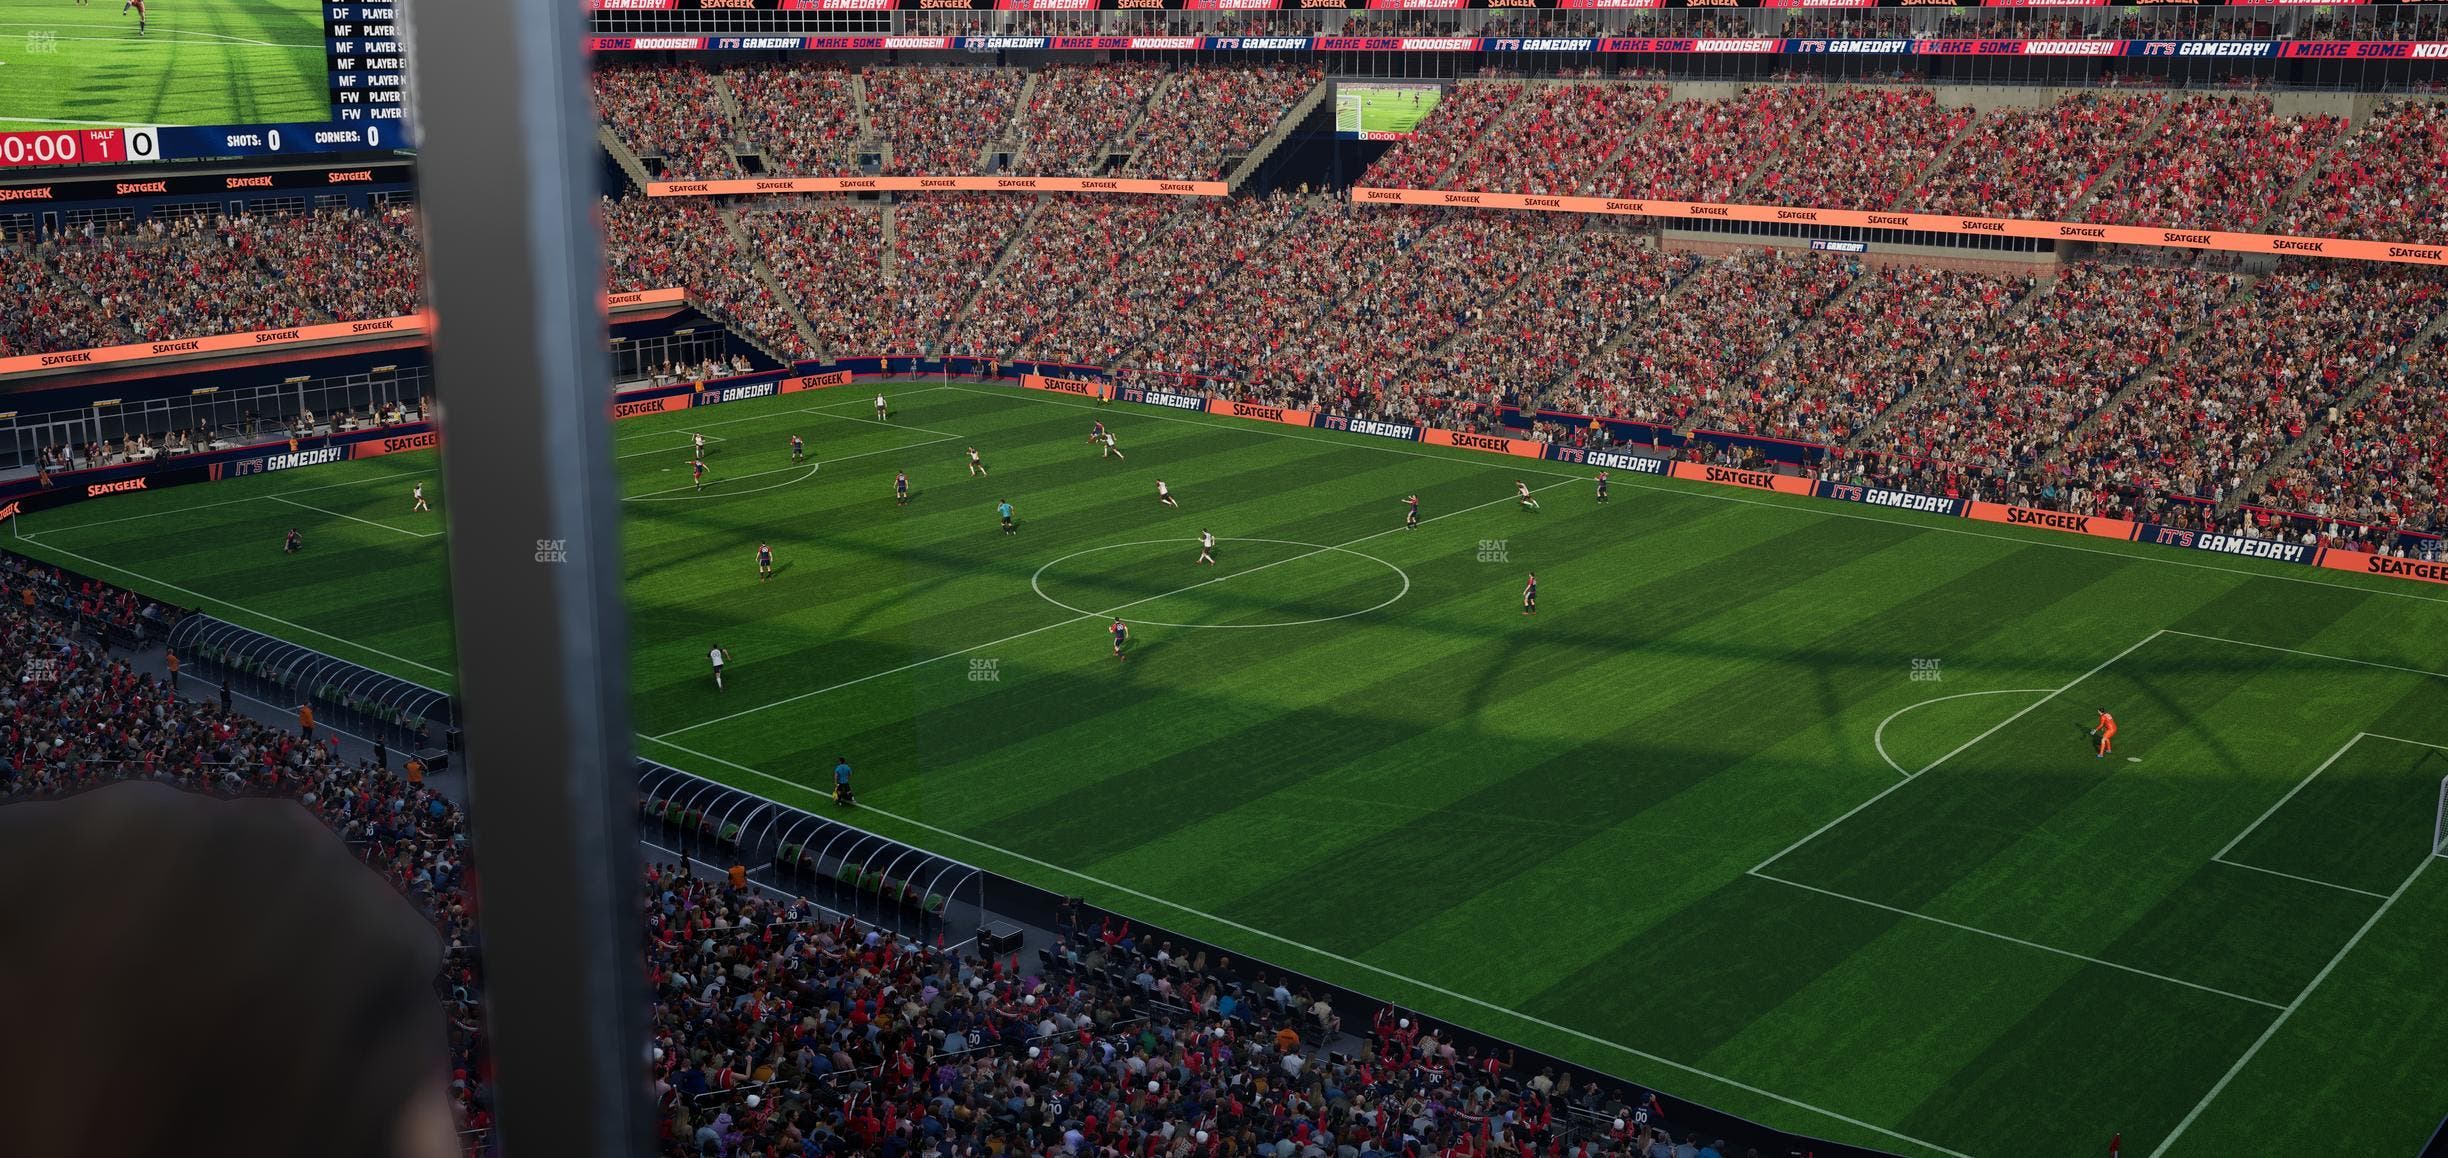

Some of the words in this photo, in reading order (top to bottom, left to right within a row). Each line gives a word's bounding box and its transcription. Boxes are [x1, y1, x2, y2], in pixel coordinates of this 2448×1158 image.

[920, 0, 971, 8] SEATGEEK
[1118, 0, 1163, 8] SEATGEEK
[333, 8, 349, 19] DF
[362, 9, 393, 19] PLAYER
[335, 25, 352, 36] MF
[364, 25, 395, 36] PLAYER
[336, 42, 353, 53] MF
[365, 42, 396, 53] PLAYER
[600, 39, 632, 48] SOME
[743, 39, 800, 48] GAMEDAY!
[816, 39, 848, 48] MAKE
[853, 39, 882, 48] SOME
[988, 39, 1045, 48] GAMEDAY!
[1061, 39, 1093, 48] MAKE
[1098, 39, 1128, 48] SOME
[1216, 39, 1240, 48] IT'S
[1242, 39, 1306, 48] GAMEDAY!
[1324, 39, 1360, 49] MAKE
[1365, 39, 1399, 49] SOME
[1494, 40, 1520, 50] IT'S
[1522, 40, 1592, 50] GAMEDAY!
[1610, 40, 1650, 50] MAKE
[1655, 40, 1693, 51] SOME
[1798, 41, 1826, 52] IT'S
[1829, 41, 1907, 52] GAMEDAY!
[1978, 42, 2022, 53] SOME
[2144, 43, 2176, 55] IT'S
[2179, 43, 2270, 56] GAMEDAY!
[2296, 44, 2350, 56] MAKE
[2356, 44, 2410, 56] SOME
[337, 59, 355, 70] MF
[366, 59, 397, 69] PLAYER
[339, 75, 356, 87] MF
[368, 75, 399, 86] PLAYER
[341, 92, 360, 103] FW
[369, 92, 400, 102] PLAYER
[342, 109, 361, 120] FW
[371, 108, 401, 119] PLAYER
[90, 131, 114, 140] HALF
[227, 135, 262, 147] SHOTS:
[268, 129, 281, 151] 0
[315, 130, 361, 144] CORNERS:
[367, 126, 379, 147] 0
[0, 134, 76, 163] 0:00
[100, 141, 108, 159] 1
[132, 132, 152, 156] 0
[226, 176, 273, 189] SEATGEEK
[328, 170, 373, 183] SEATGEEK
[116, 181, 167, 195] SEATGEEK
[669, 184, 708, 192] SEATGEEK
[757, 182, 793, 190] SEATGEEK
[840, 180, 875, 188] SEATGEEK
[1160, 183, 1194, 191] SEATGEEK
[0, 187, 53, 201] SEATGEEK
[1368, 191, 1401, 199] SEATGEEK
[1445, 194, 1480, 203] SEATGEEK
[1525, 198, 1560, 207] SEATGEEK
[1606, 202, 1643, 211] SEATGEEK
[1691, 206, 1728, 215] SEATGEEK
[1778, 210, 1816, 220] SEATGEEK
[1868, 216, 1908, 225] SEATGEEK
[1962, 221, 2005, 231] SEATGEEK
[2060, 227, 2106, 237] SEATGEEK
[2164, 233, 2211, 245] SEATGEEK
[2273, 240, 2323, 252] SEATGEEK
[2389, 247, 2442, 260] SEATGEEK
[608, 294, 642, 304] SEATGEEK
[353, 320, 393, 332] SEATGEEK
[256, 330, 299, 343] SEATGEEK
[153, 341, 199, 354] SEATGEEK
[42, 352, 91, 366] SEATGEEK
[802, 373, 843, 389] SEATGEEK
[1044, 378, 1088, 394] SEATGEEK
[701, 391, 720, 405] IT'S
[723, 383, 773, 401] GAMEDAY!
[1124, 389, 1143, 402] IT'S
[1146, 392, 1200, 410] GAMEDAY!
[616, 399, 665, 417] SEATGEEK
[1233, 403, 1283, 421] SEATGEEK
[1325, 416, 1348, 430] IT'S
[1350, 420, 1413, 439] GAMEDAY!
[1451, 433, 1510, 453] SEATGEEK
[236, 458, 263, 476] IT'S
[267, 447, 341, 471] GAMEDAY!
[1557, 448, 1583, 463] IT'S
[1587, 452, 1660, 473] GAMEDAY!
[1706, 467, 1775, 489] SEATGEEK
[87, 477, 147, 497] SEATGEEK
[1831, 484, 1862, 501] IT'S
[1865, 489, 1953, 514] GAMEDAY!
[2006, 507, 2089, 532] SEATGEEK
[2156, 528, 2195, 547] IT'S
[2198, 534, 2304, 561] GAMEDAY!
